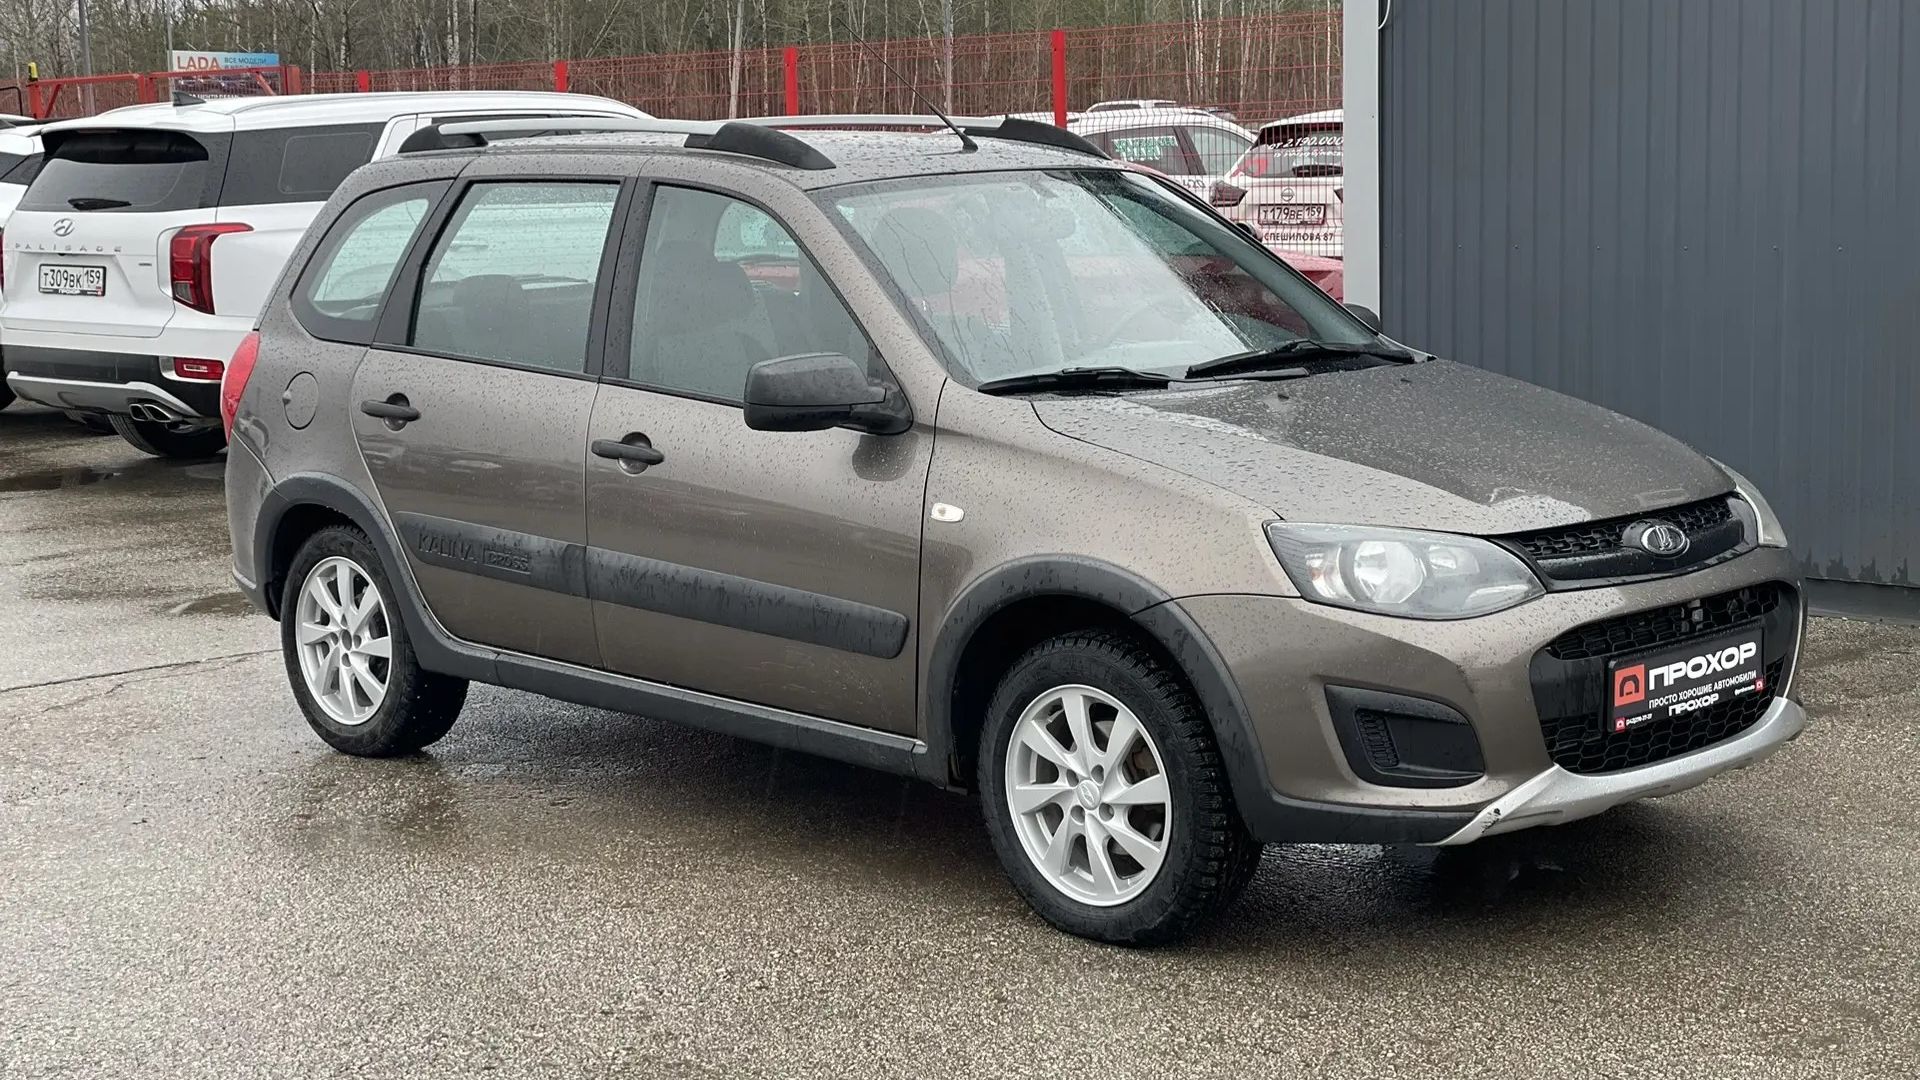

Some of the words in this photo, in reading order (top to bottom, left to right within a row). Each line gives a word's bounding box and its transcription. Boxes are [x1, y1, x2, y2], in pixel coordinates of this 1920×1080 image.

[177, 56, 222, 70] LADA
[238, 57, 267, 65] МОДЕЛИ
[1305, 206, 1322, 217] 159
[1264, 232, 1322, 241] СПЕШИЛОВА
[1323, 232, 1334, 241] 87
[15, 243, 122, 253] PALISADE
[43, 269, 82, 288] Т309ВК
[84, 269, 101, 285] 159
[419, 533, 478, 564] KALINA
[488, 553, 529, 572] CROSS
[1649, 641, 1757, 690] ПРОХОР
[1649, 693, 1678, 709] ПРОСТО
[1678, 684, 1713, 702] ХОРОШИЕ
[1713, 670, 1757, 691] АВТОМОБИЛИ
[1668, 692, 1720, 717] ПРОХОР
